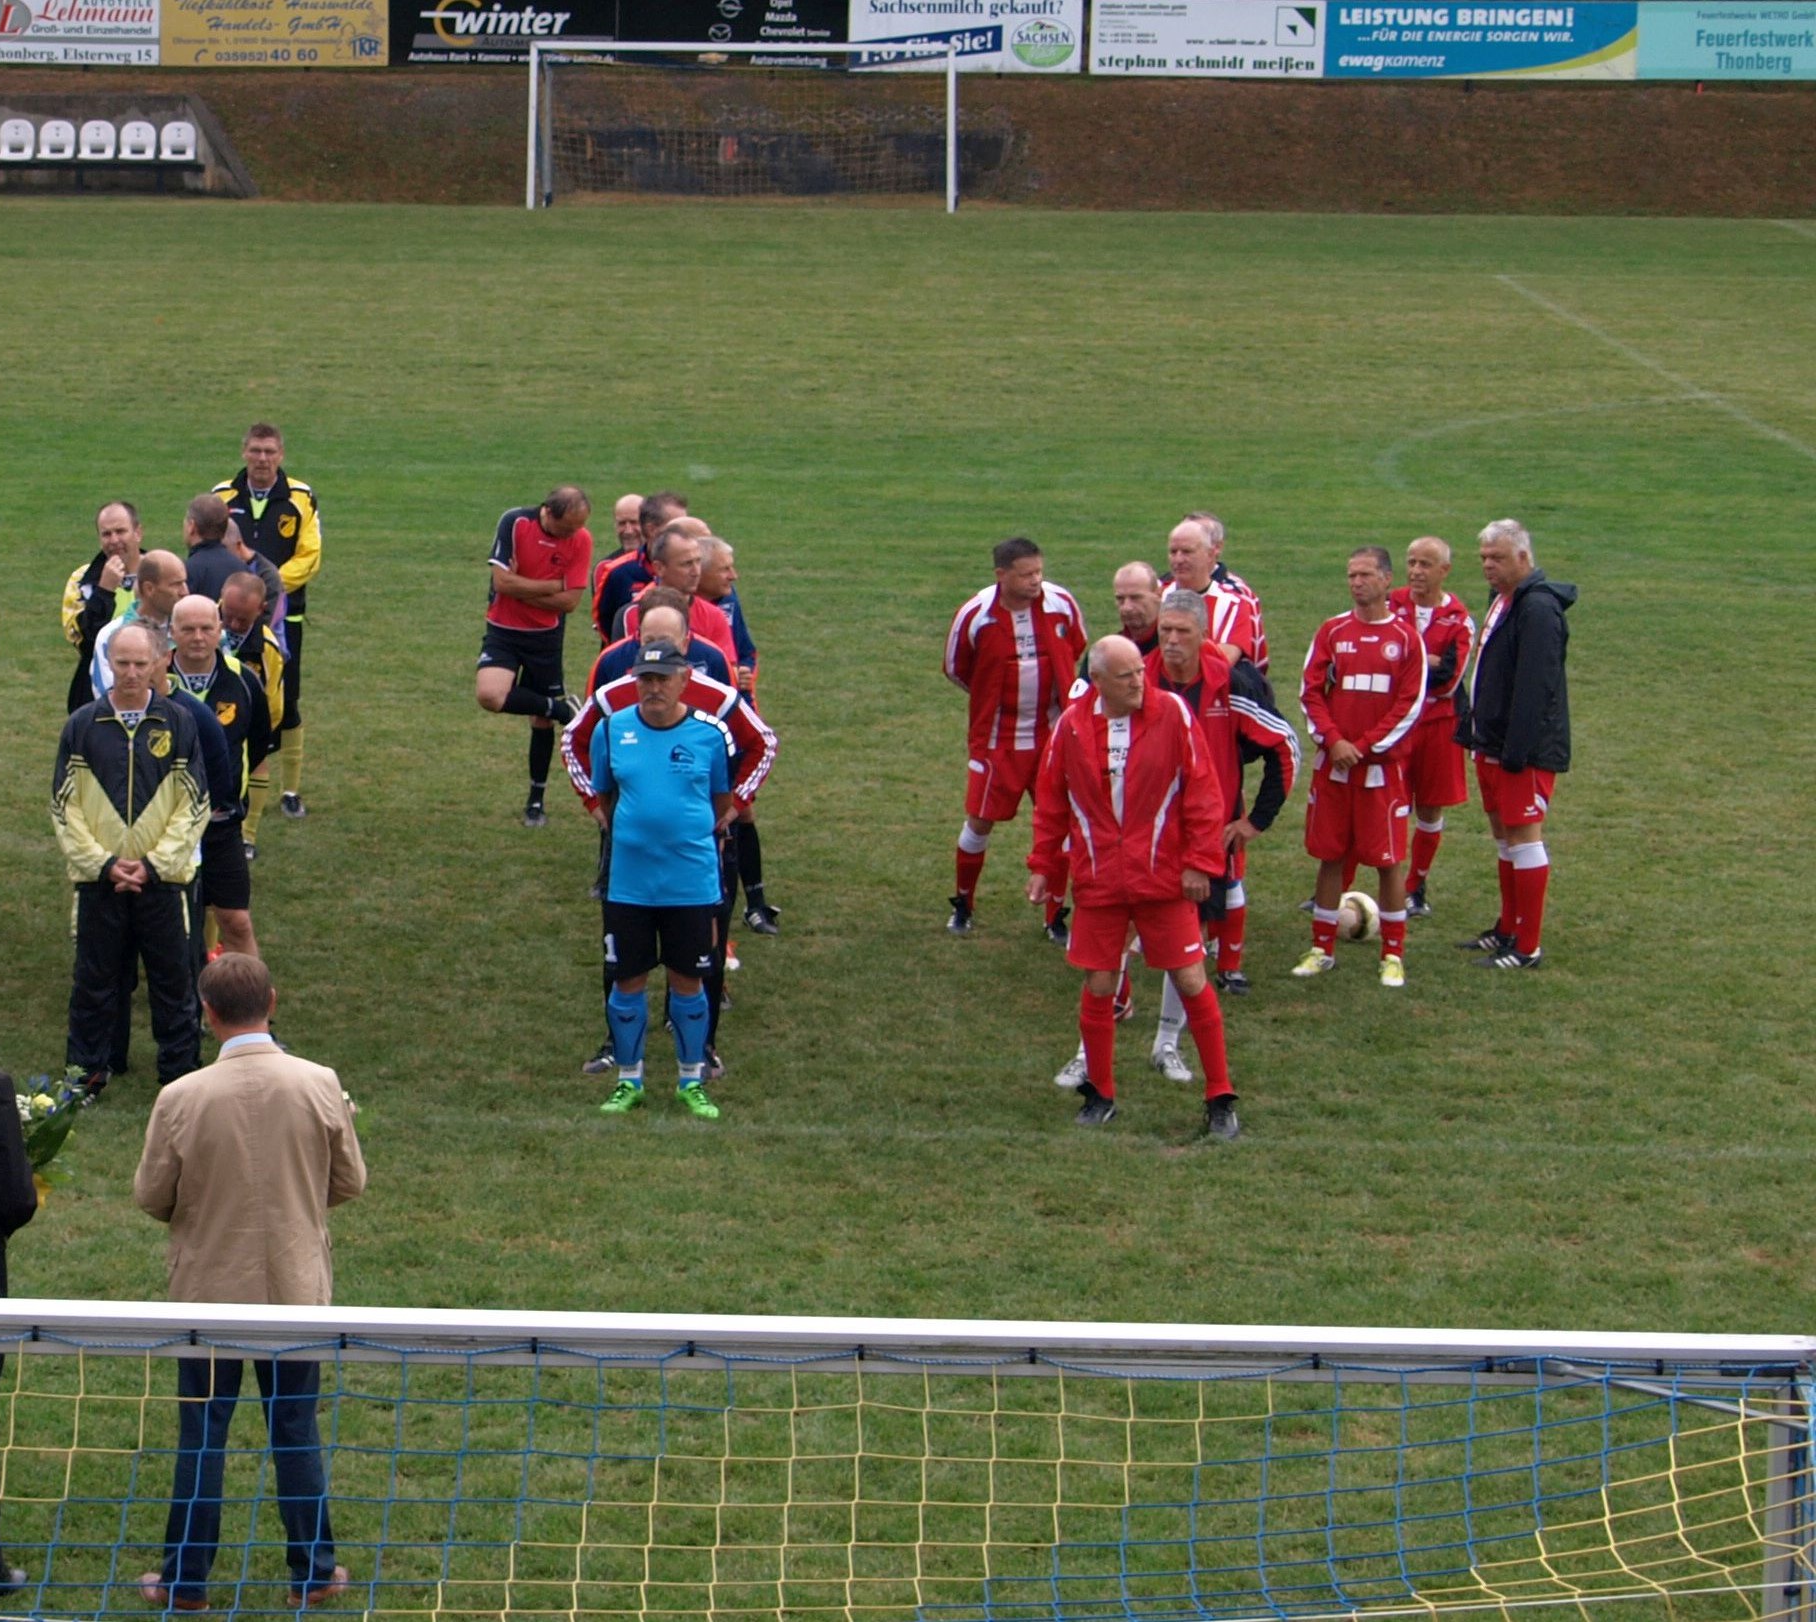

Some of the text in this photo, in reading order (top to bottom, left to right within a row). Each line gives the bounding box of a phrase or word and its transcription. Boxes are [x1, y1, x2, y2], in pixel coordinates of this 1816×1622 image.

[36, 0, 154, 22] Lehmann
[868, 0, 1063, 17] Sachsenmilch gekauft?
[454, 3, 571, 35] winter
[764, 12, 797, 22] Mazda
[1339, 8, 1574, 28] LEISTUNG BRINGEN!
[32, 24, 153, 36] Groß- und Einzelhandel
[206, 16, 342, 35] Handels- GmbH
[759, 26, 805, 37] Chevrolet
[949, 31, 994, 51] Sie!
[1017, 31, 1070, 44] SACHSEN
[1401, 30, 1423, 42] DIE
[1427, 30, 1483, 42] ENERGIE
[1486, 30, 1538, 43] SORGEN
[1543, 31, 1574, 43] WIR.
[64, 48, 132, 64] Elsterweg
[137, 49, 153, 63] 15
[270, 49, 291, 62] 40
[296, 49, 318, 61] 60
[749, 54, 828, 68] Autovermietung
[1098, 54, 1315, 73] stephan schmidt meißen
[1715, 52, 1793, 74] Thonberg
[1335, 641, 1358, 654] ML
[604, 933, 618, 963] 1
